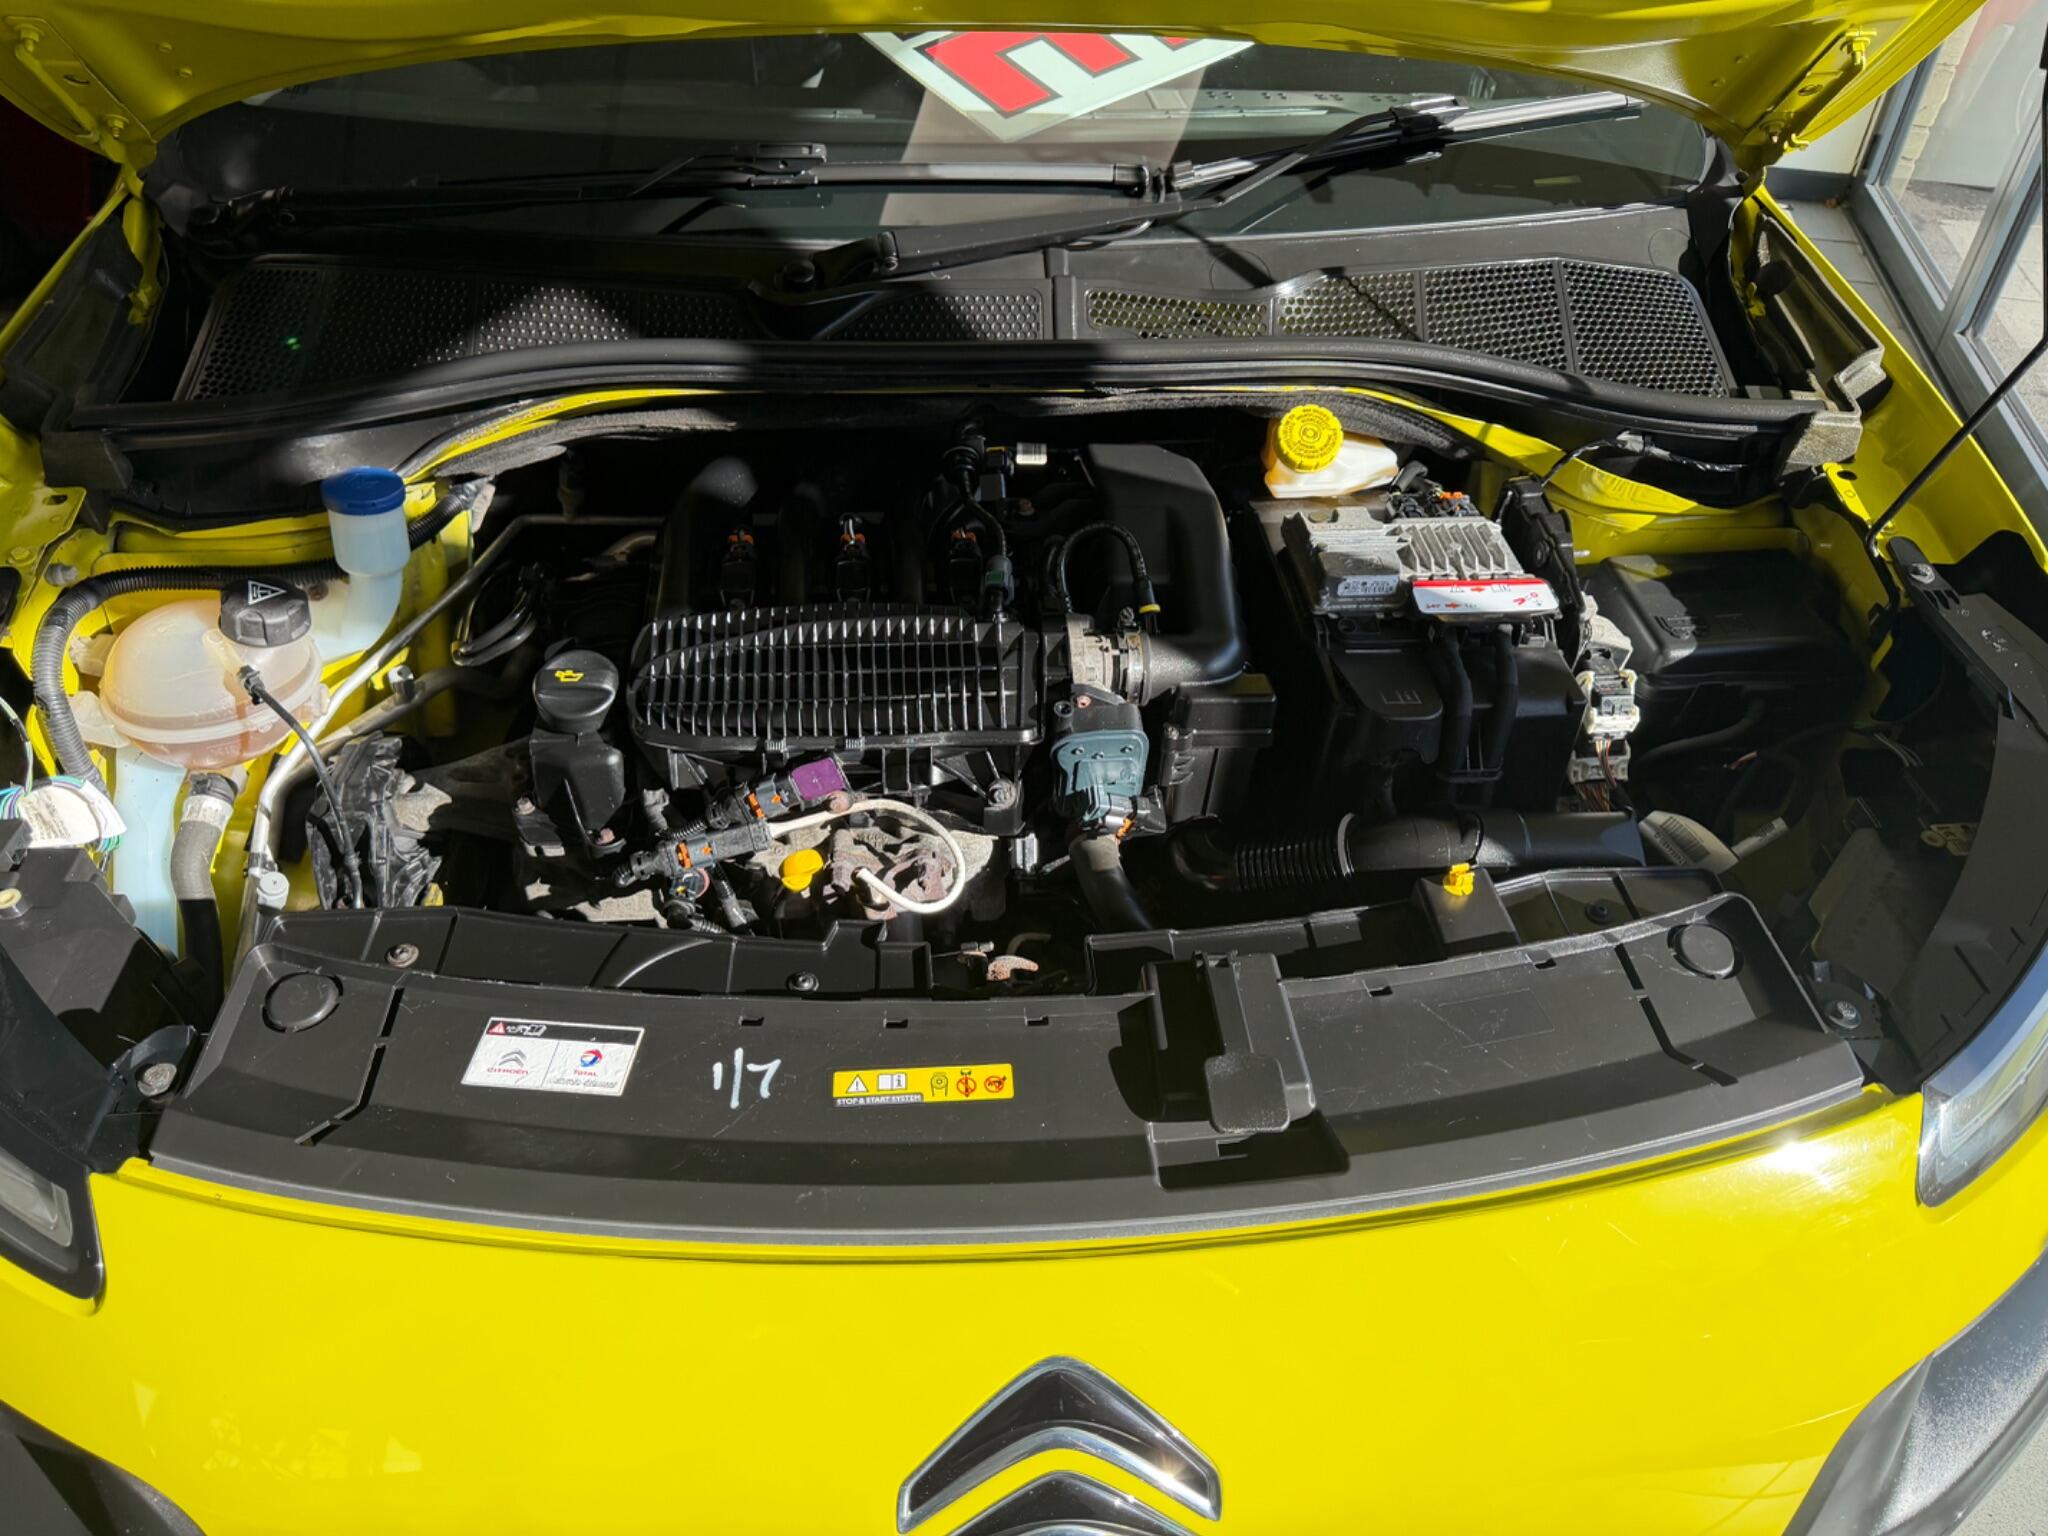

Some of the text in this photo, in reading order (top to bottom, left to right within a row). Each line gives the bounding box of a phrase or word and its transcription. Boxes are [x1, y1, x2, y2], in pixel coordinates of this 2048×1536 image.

[836, 1098, 859, 1106] STOP
[865, 1095, 891, 1104] START
[891, 1094, 922, 1103] SYSTEM
